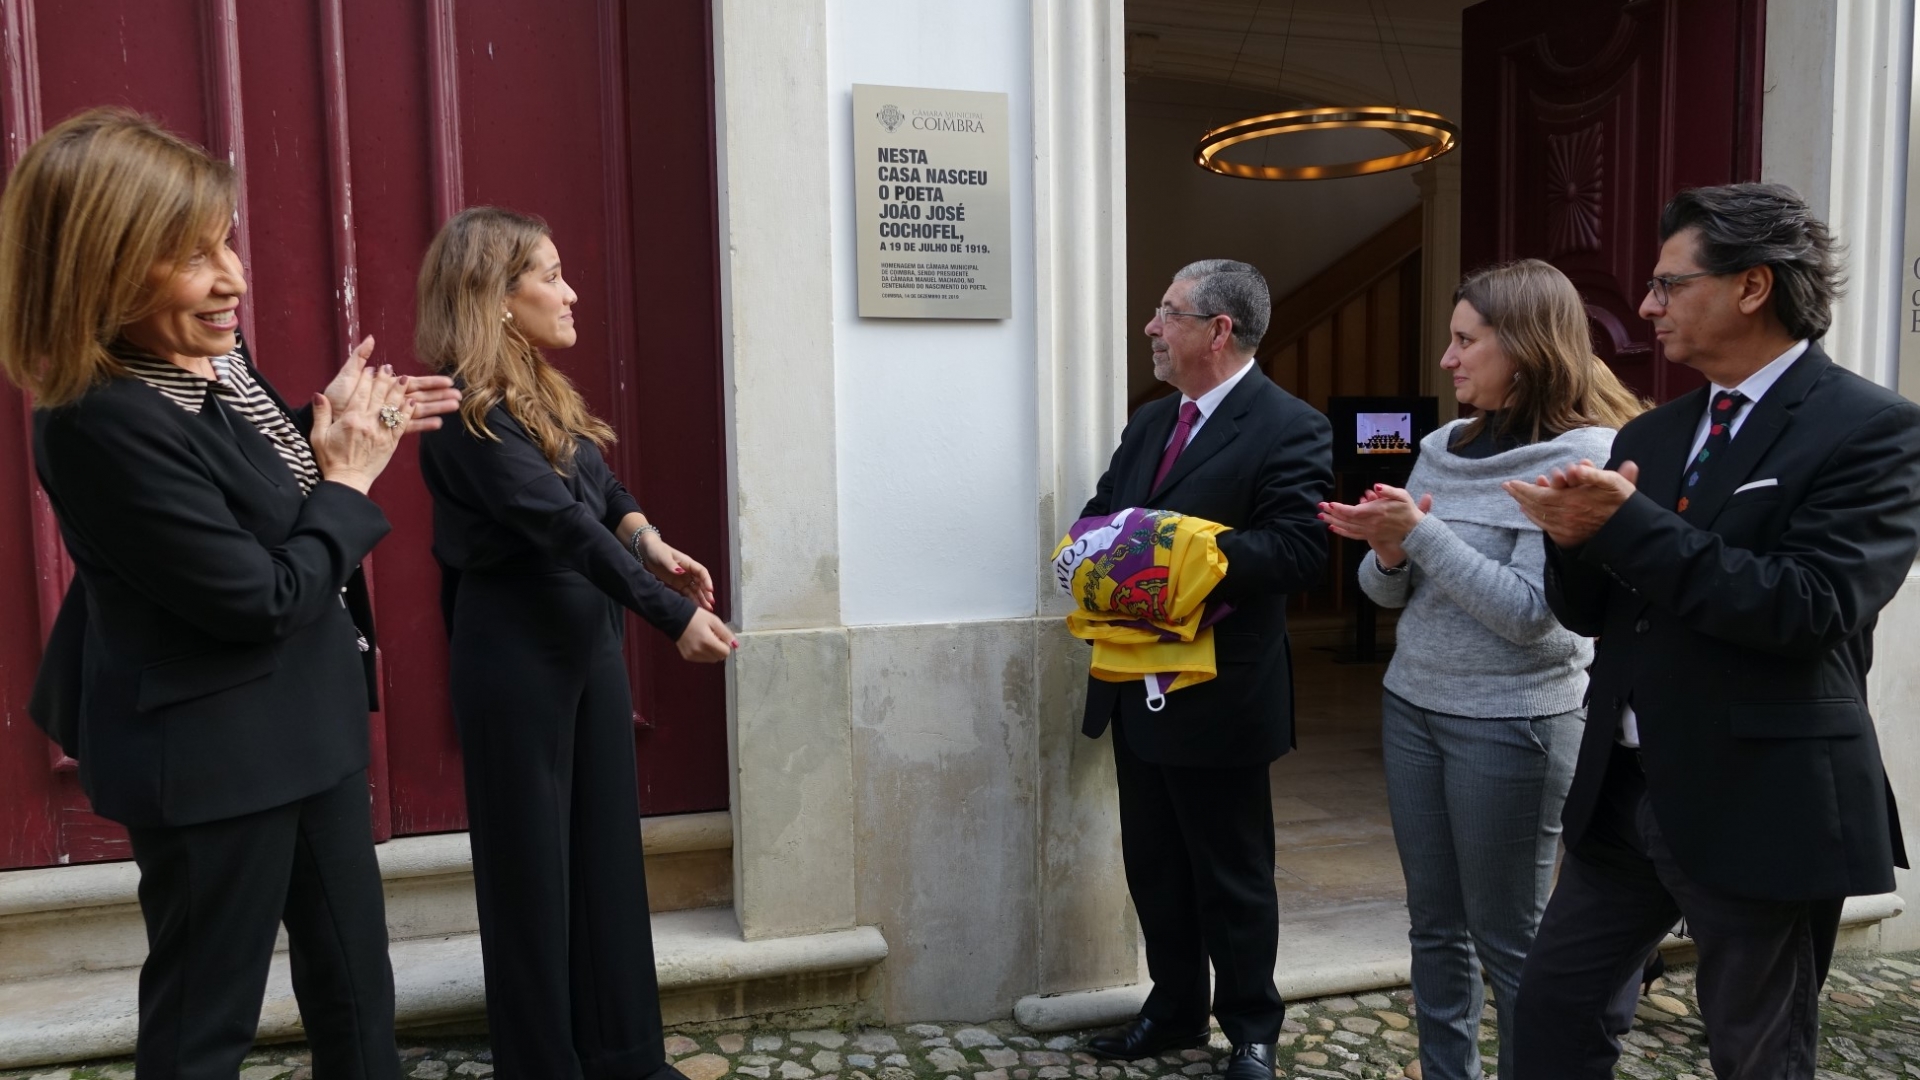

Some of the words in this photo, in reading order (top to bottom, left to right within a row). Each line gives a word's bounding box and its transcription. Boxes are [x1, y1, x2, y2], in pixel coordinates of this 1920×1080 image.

[912, 108, 943, 117] CÂMARA
[945, 110, 983, 120] MUNICIPAL
[912, 117, 985, 133] COIMBRA
[877, 147, 928, 165] NESTA
[878, 166, 921, 183] CASA
[926, 168, 988, 186] NASCEU
[879, 185, 890, 200] O
[895, 186, 944, 202] POETA
[879, 201, 921, 220] JOÃO
[925, 203, 965, 222] JOSÉ
[879, 222, 964, 243] COCHOFEL,
[880, 241, 887, 251] A
[890, 242, 901, 251] 19
[904, 243, 916, 252] DE
[918, 243, 948, 253] JULHO
[950, 244, 962, 253] DE
[965, 244, 990, 254] 1919.
[926, 262, 949, 270] CÂMARA
